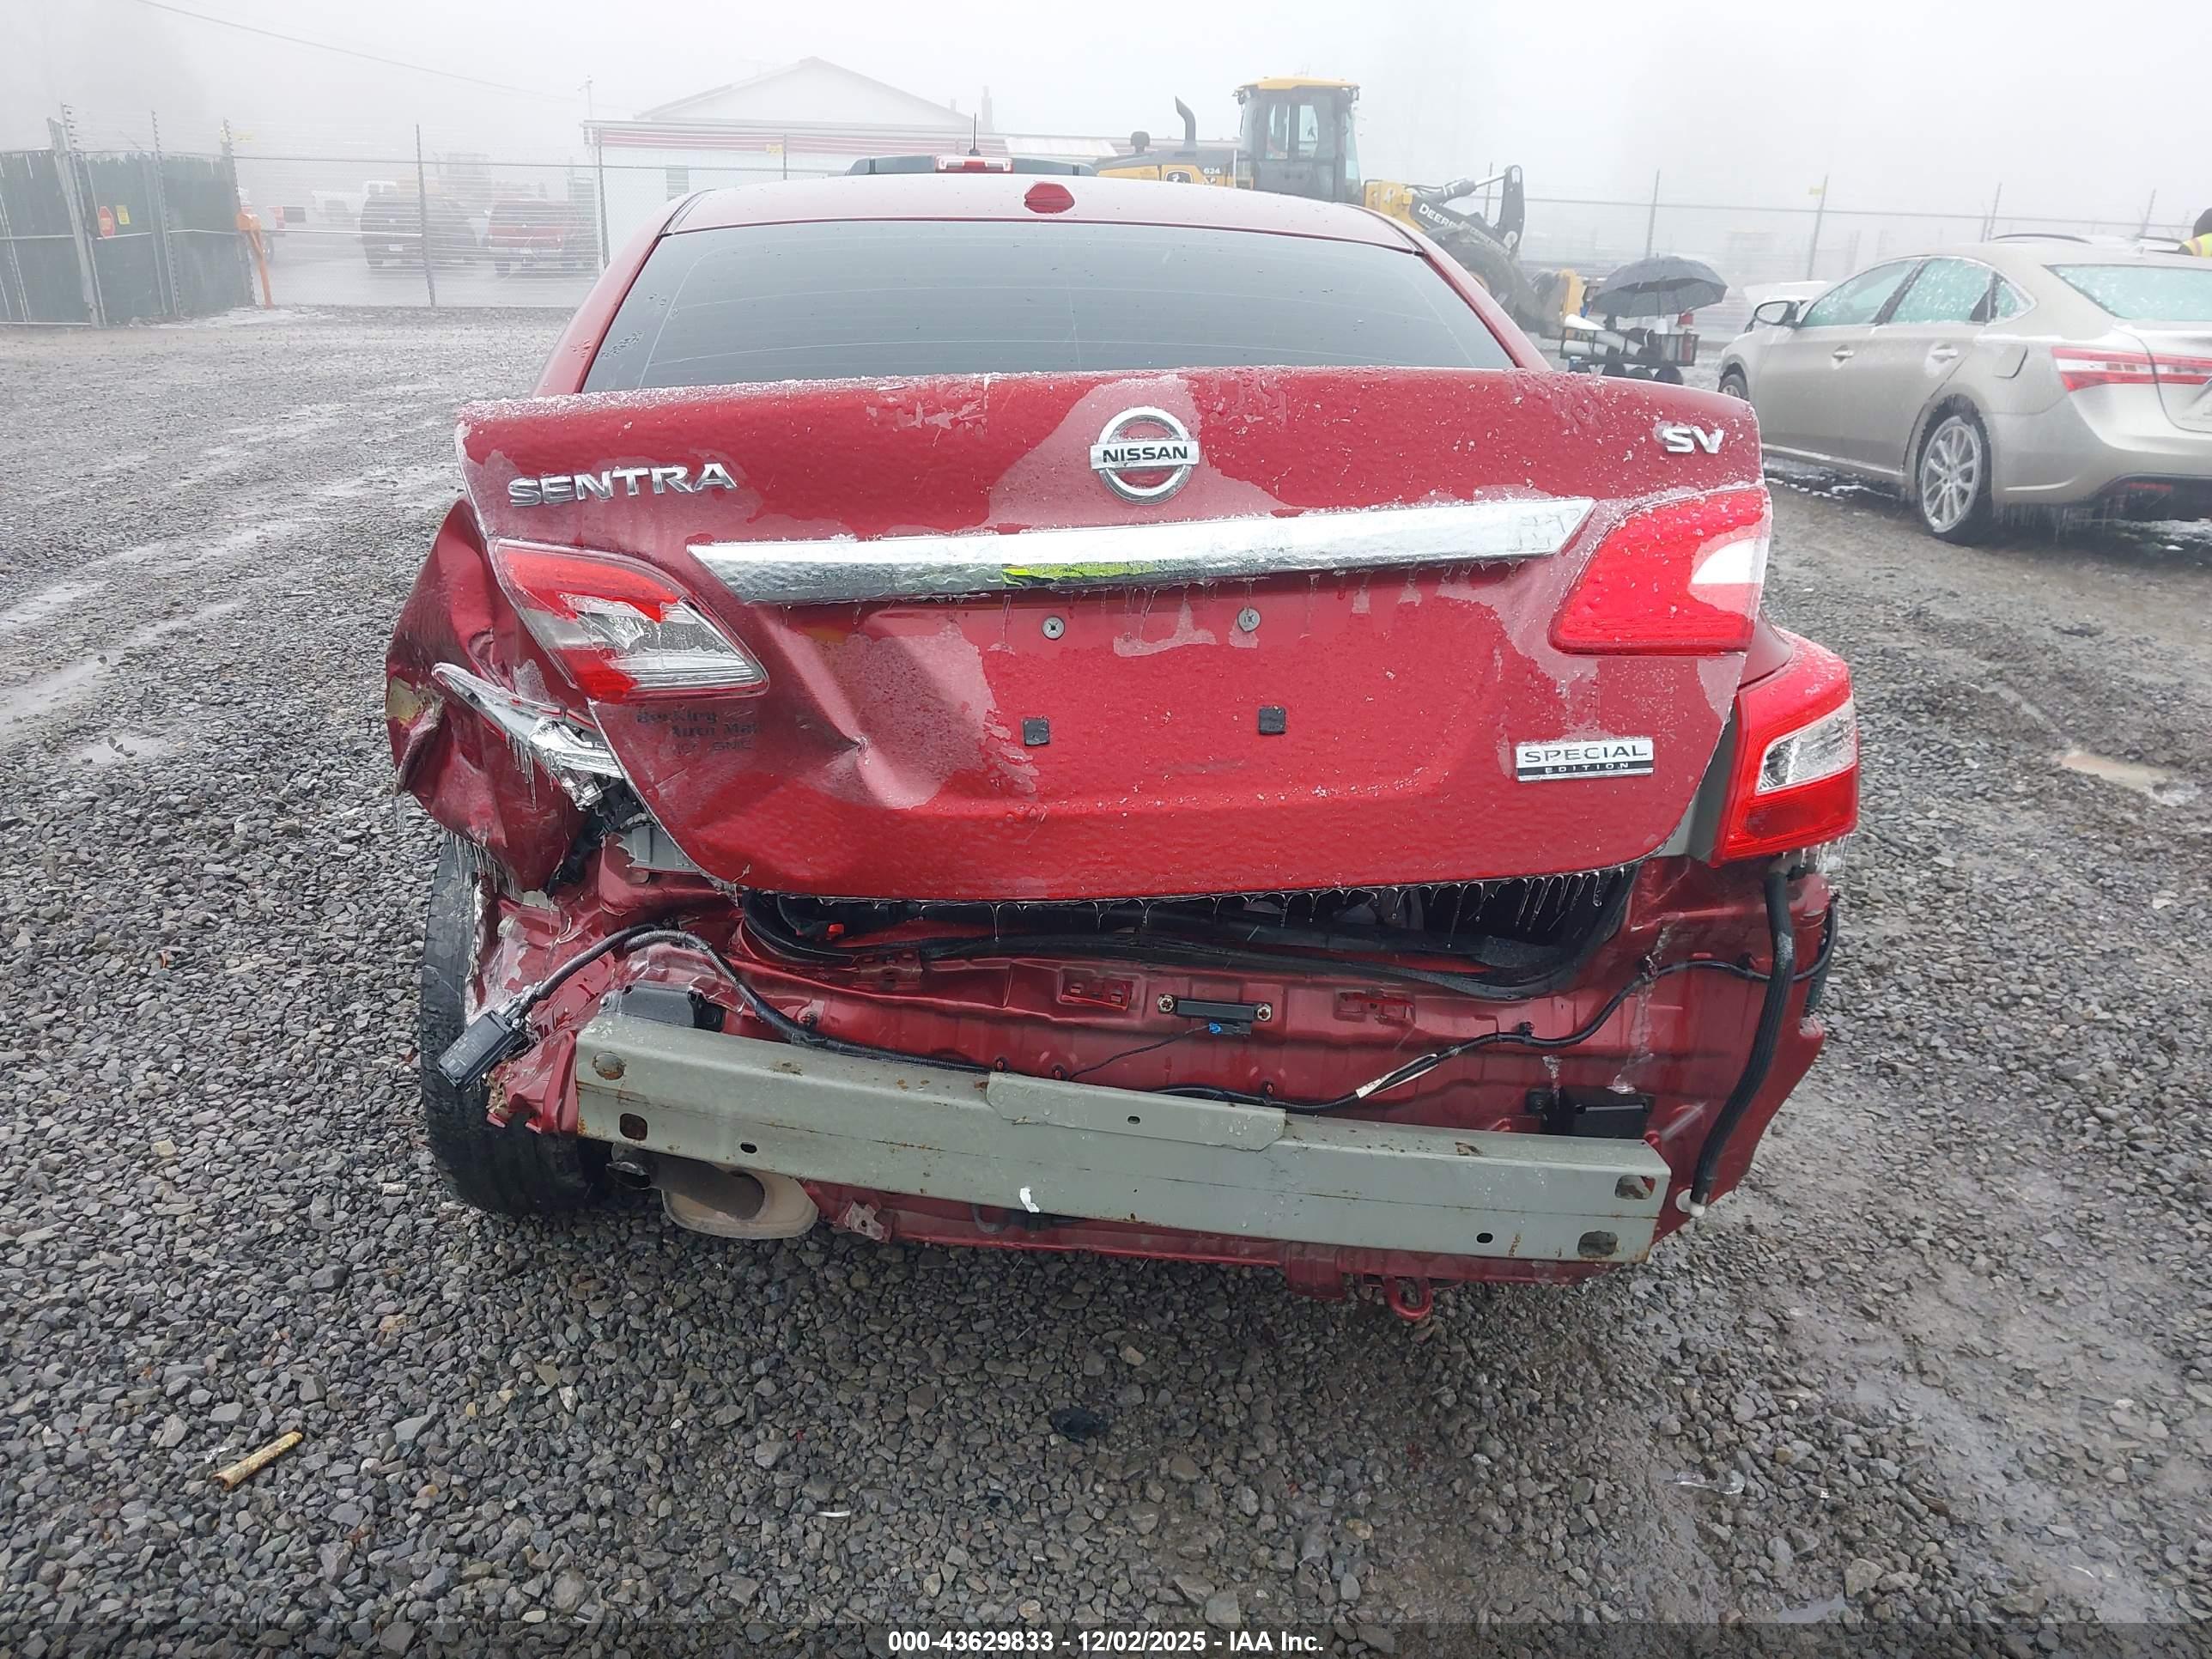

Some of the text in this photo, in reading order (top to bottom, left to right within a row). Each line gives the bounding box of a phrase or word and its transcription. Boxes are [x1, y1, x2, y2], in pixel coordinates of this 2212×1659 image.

[1662, 424, 1724, 453] SV
[1103, 446, 1188, 463] NISSAN
[507, 462, 738, 507] SENTRA
[1524, 744, 1649, 763] SPECIAL
[1545, 762, 1630, 774] EDITION
